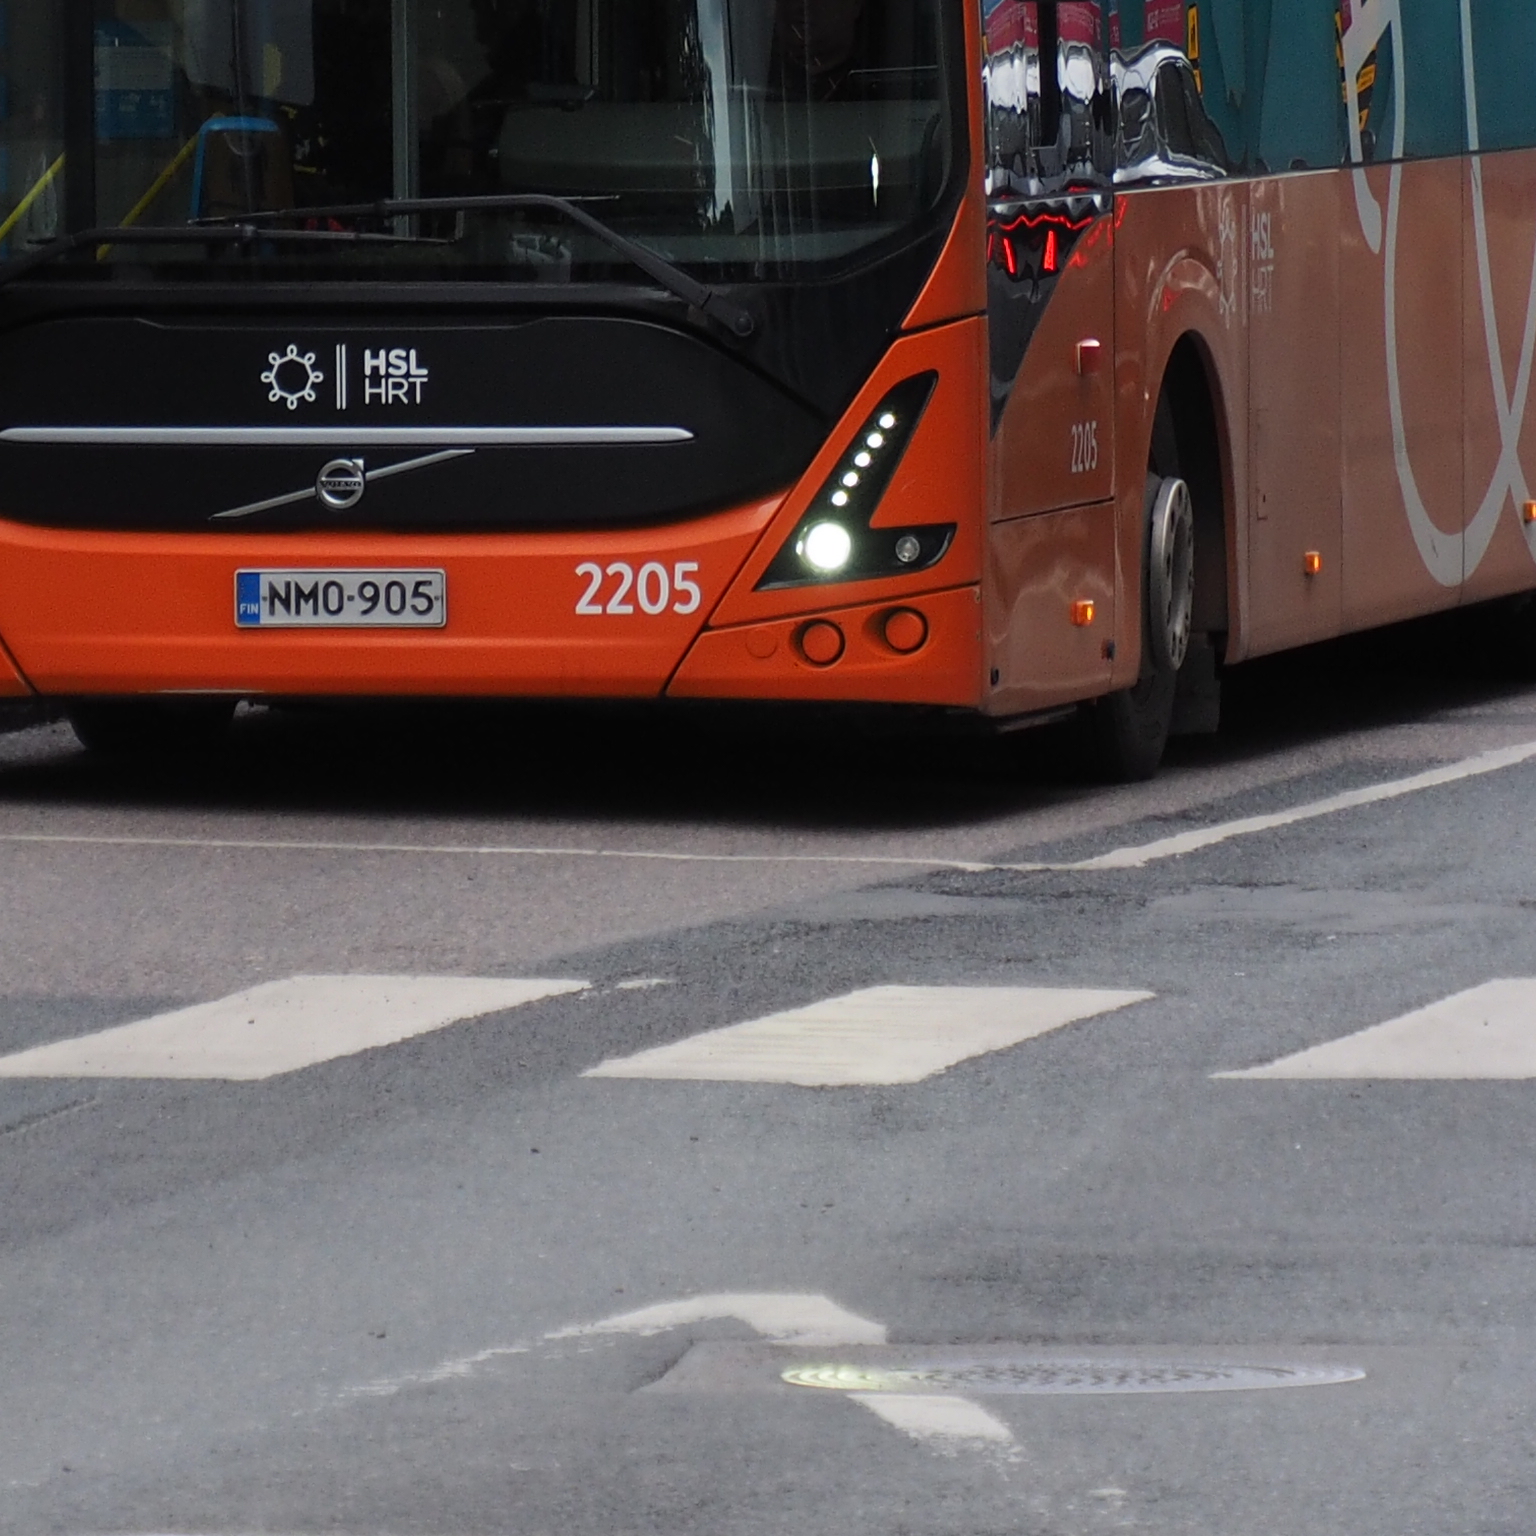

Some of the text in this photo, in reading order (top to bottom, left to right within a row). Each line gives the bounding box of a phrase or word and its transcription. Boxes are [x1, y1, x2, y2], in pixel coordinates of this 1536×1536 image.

[364, 349, 429, 376] HSL
[364, 377, 429, 405] HRT
[1071, 420, 1098, 473] 2205
[267, 579, 434, 617] NMO-905
[574, 561, 701, 616] 2205
[240, 604, 259, 615] FIN
